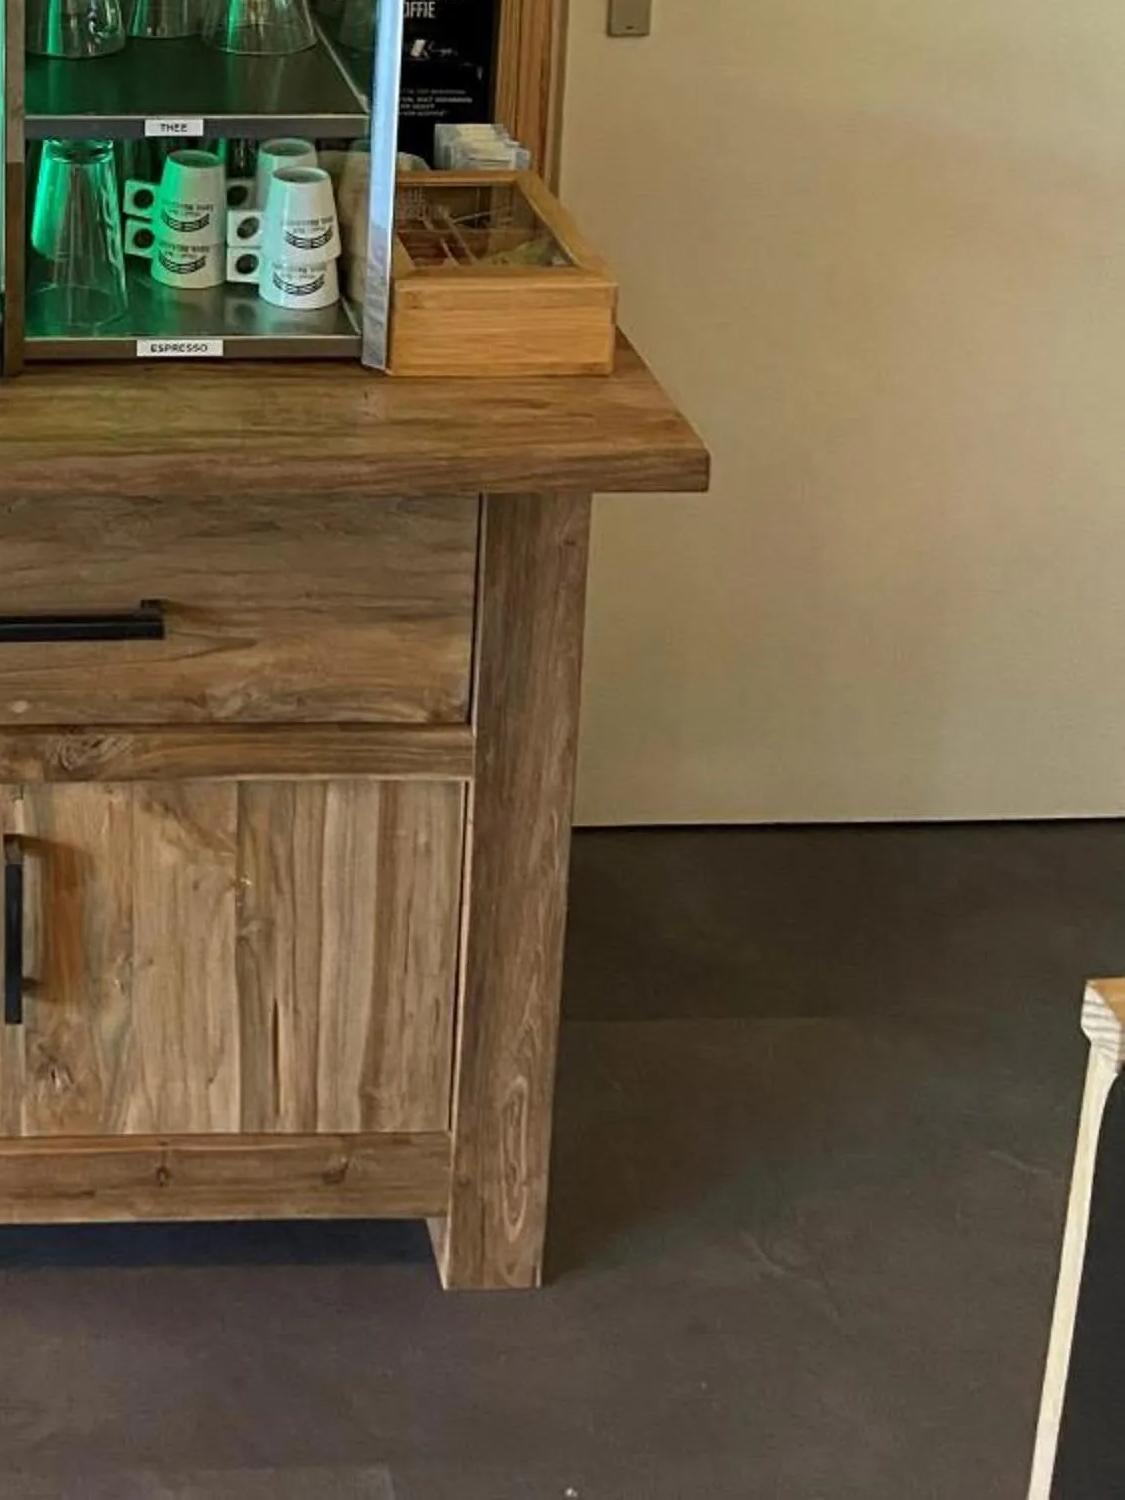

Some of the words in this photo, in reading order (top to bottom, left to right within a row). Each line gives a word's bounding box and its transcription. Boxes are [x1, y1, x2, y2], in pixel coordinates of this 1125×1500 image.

[403, 1, 436, 18] OFFIE
[160, 123, 188, 133] THEE
[150, 343, 208, 353] ESPRESSO
